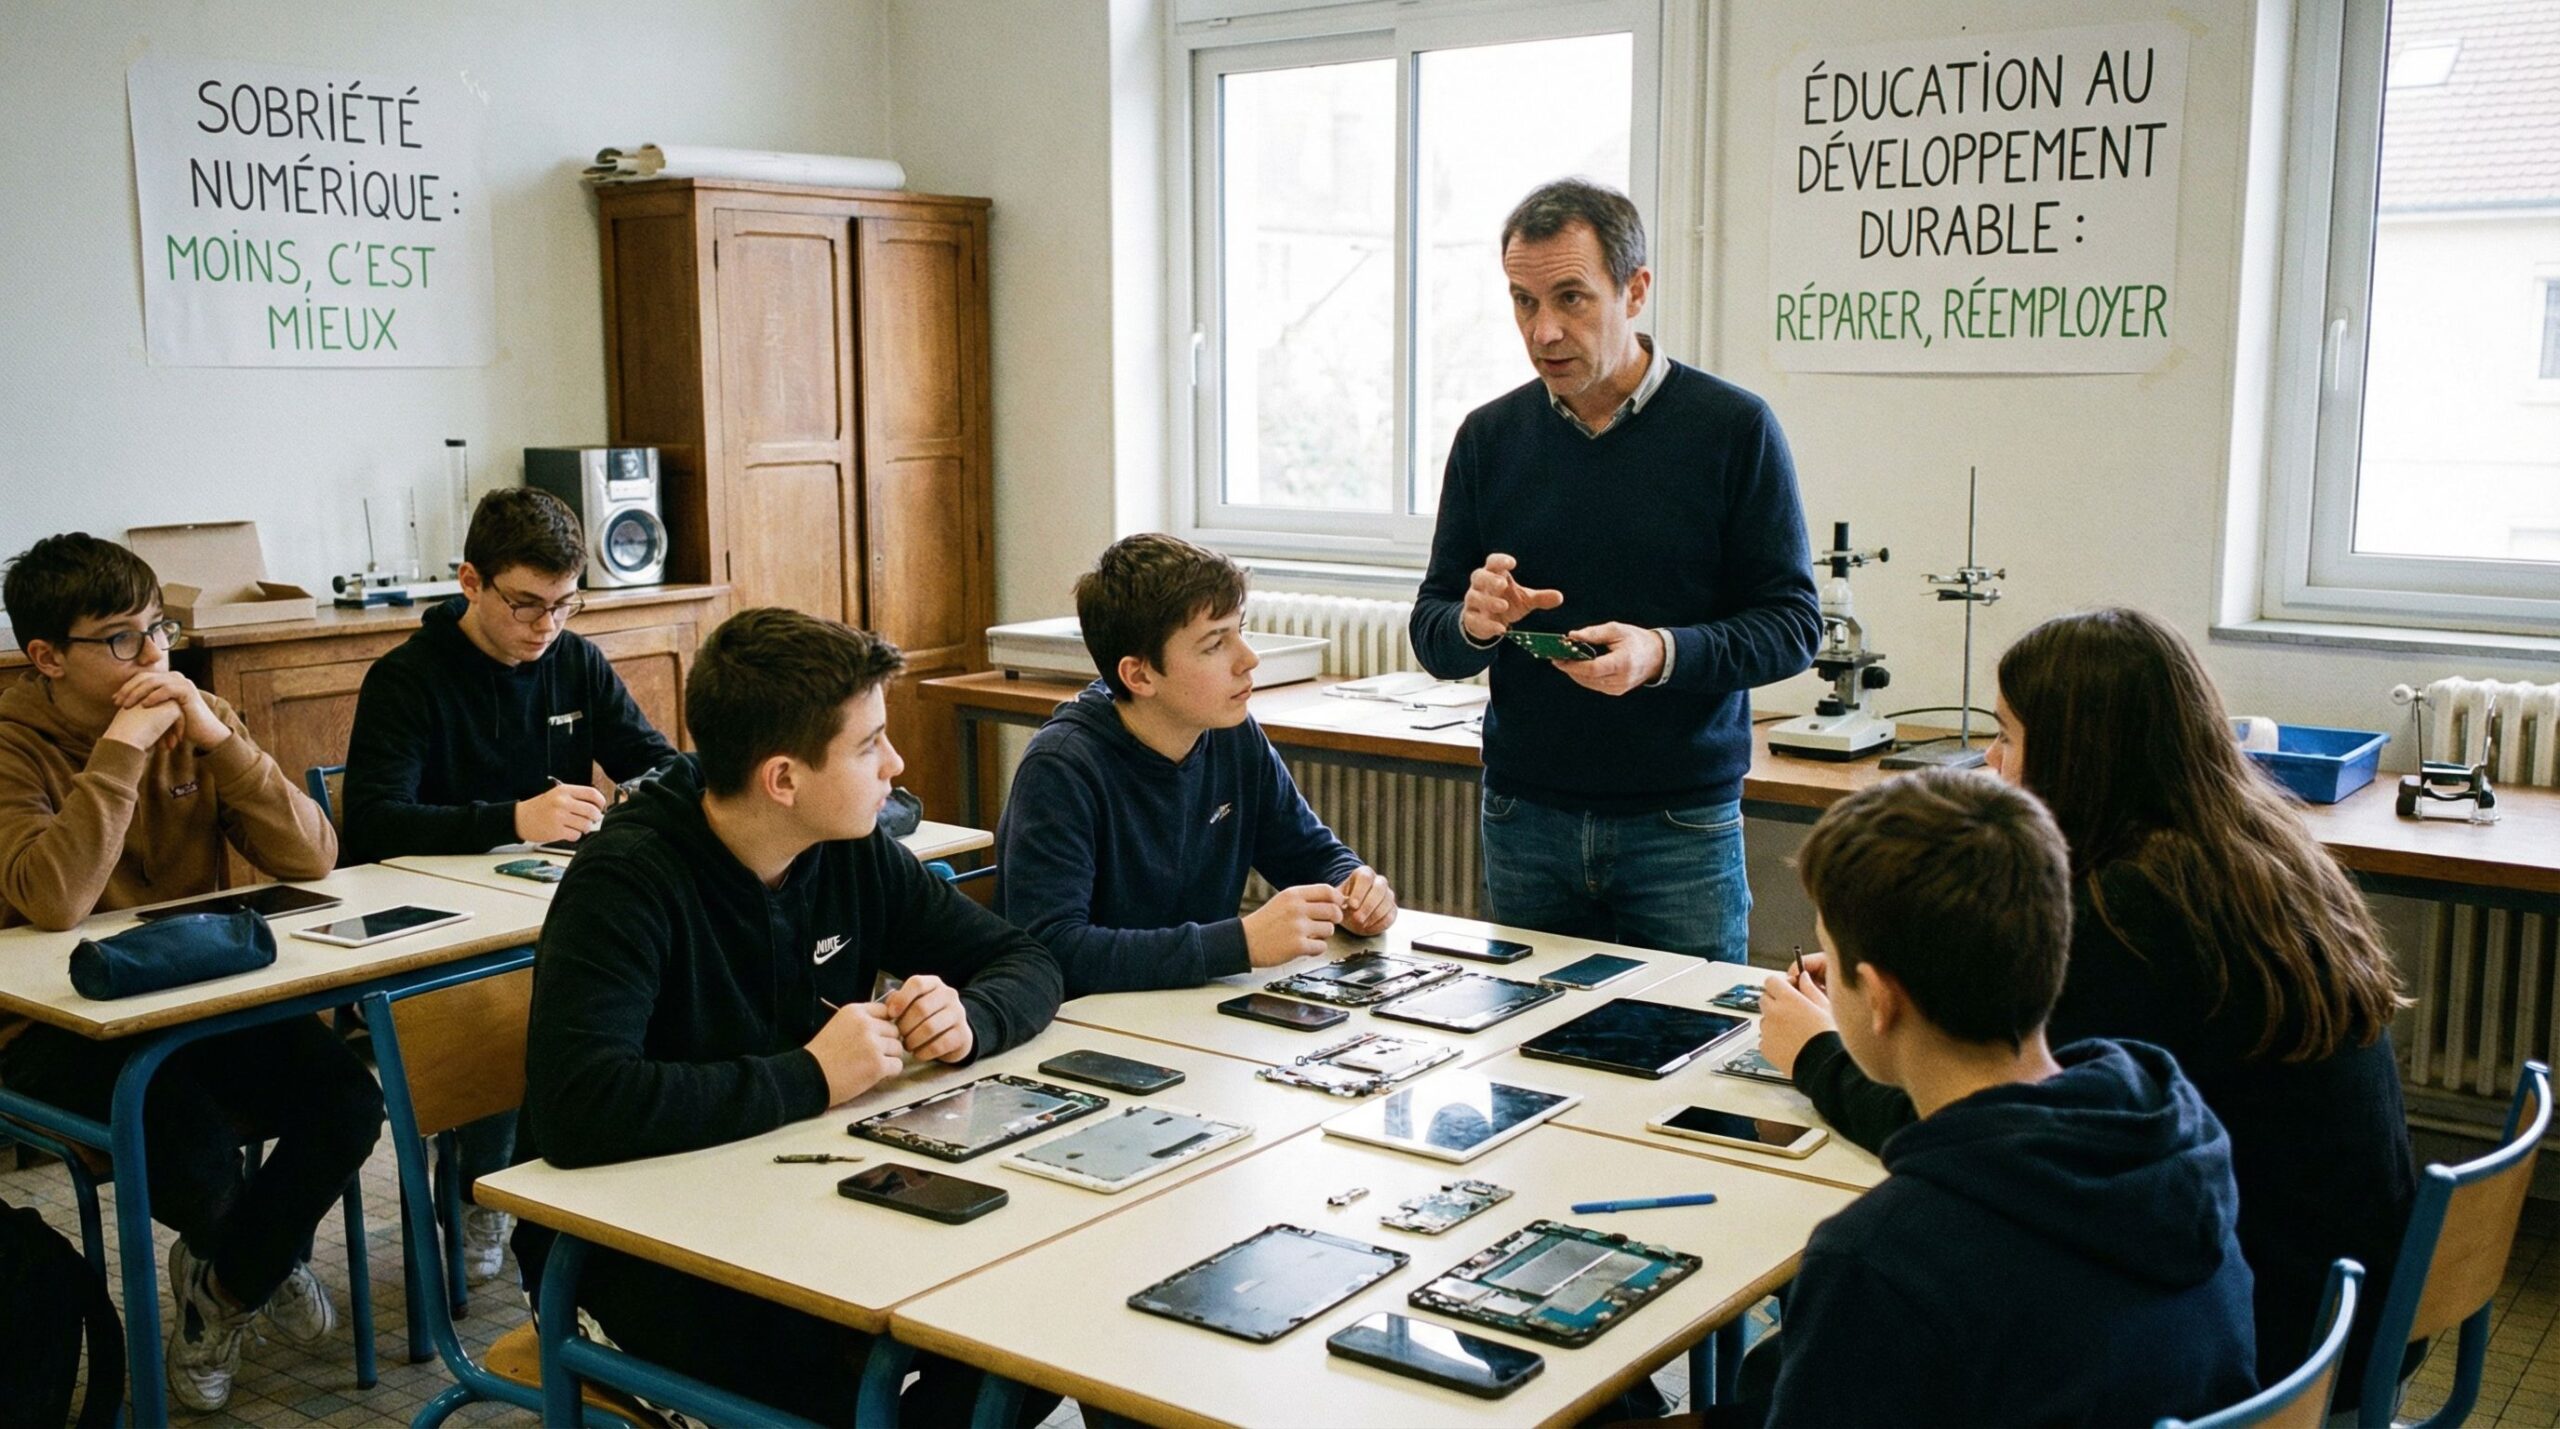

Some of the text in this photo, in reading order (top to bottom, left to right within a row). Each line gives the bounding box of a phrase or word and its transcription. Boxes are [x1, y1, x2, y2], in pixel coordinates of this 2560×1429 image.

[196, 79, 423, 149] SOBRIÉTÉ
[1804, 47, 2154, 126] ÉDUCATION AU
[1798, 122, 2168, 194] DÉVELOPPEMENT
[166, 228, 436, 294] MOINS, C'EST
[1859, 200, 2061, 260] DURABLE
[267, 297, 398, 351] MIEUX
[1776, 276, 2168, 349] RÉPARER, RÉEMPLOYER
[816, 934, 841, 954] NIKE
